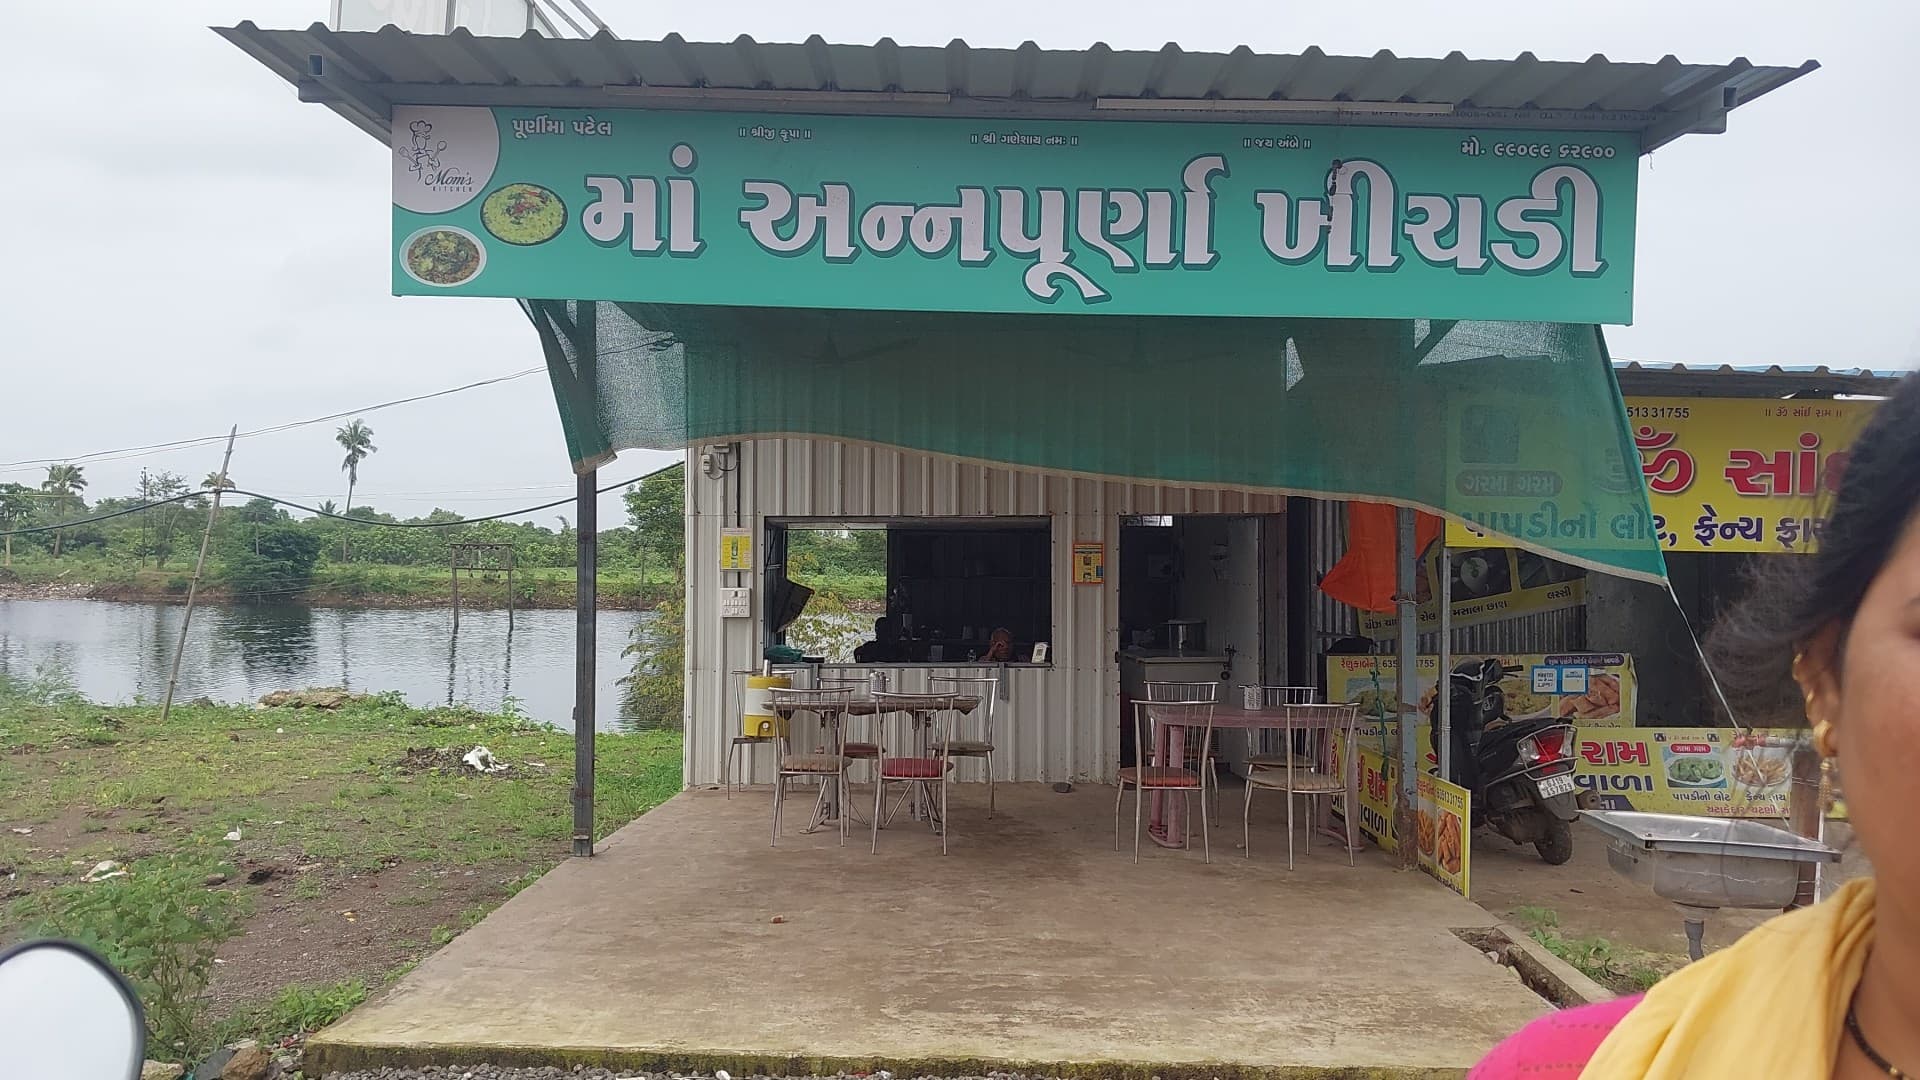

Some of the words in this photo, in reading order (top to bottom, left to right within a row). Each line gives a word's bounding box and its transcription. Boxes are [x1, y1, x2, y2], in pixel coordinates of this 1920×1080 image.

[572, 116, 612, 135] પટેલ
[751, 126, 775, 140] શ્રીજી
[779, 129, 800, 142] કૃપા
[982, 132, 996, 144] શ્રી
[1000, 131, 1042, 145] ગણેશાય
[1254, 138, 1273, 148] જય
[1277, 135, 1299, 149] અંબે
[1461, 136, 1486, 156] મો.
[1494, 142, 1551, 158] ૯૯૦૯૯
[1559, 144, 1616, 159] ૬૨૯૦૦
[424, 167, 474, 186] Mom's
[582, 142, 706, 255] માં
[738, 154, 1228, 301] અન્નપૂર્ણા
[1255, 159, 1607, 276] ખીચડી
[1626, 407, 1690, 419] 51331755
[1463, 474, 1508, 491] ગરમા
[1517, 474, 1555, 491] ગરમ
[1453, 605, 1484, 617] મસાલા
[1580, 741, 1650, 766] રામ
[1672, 790, 1711, 801] પાપડીનો
[1713, 791, 1731, 801] લોટ
